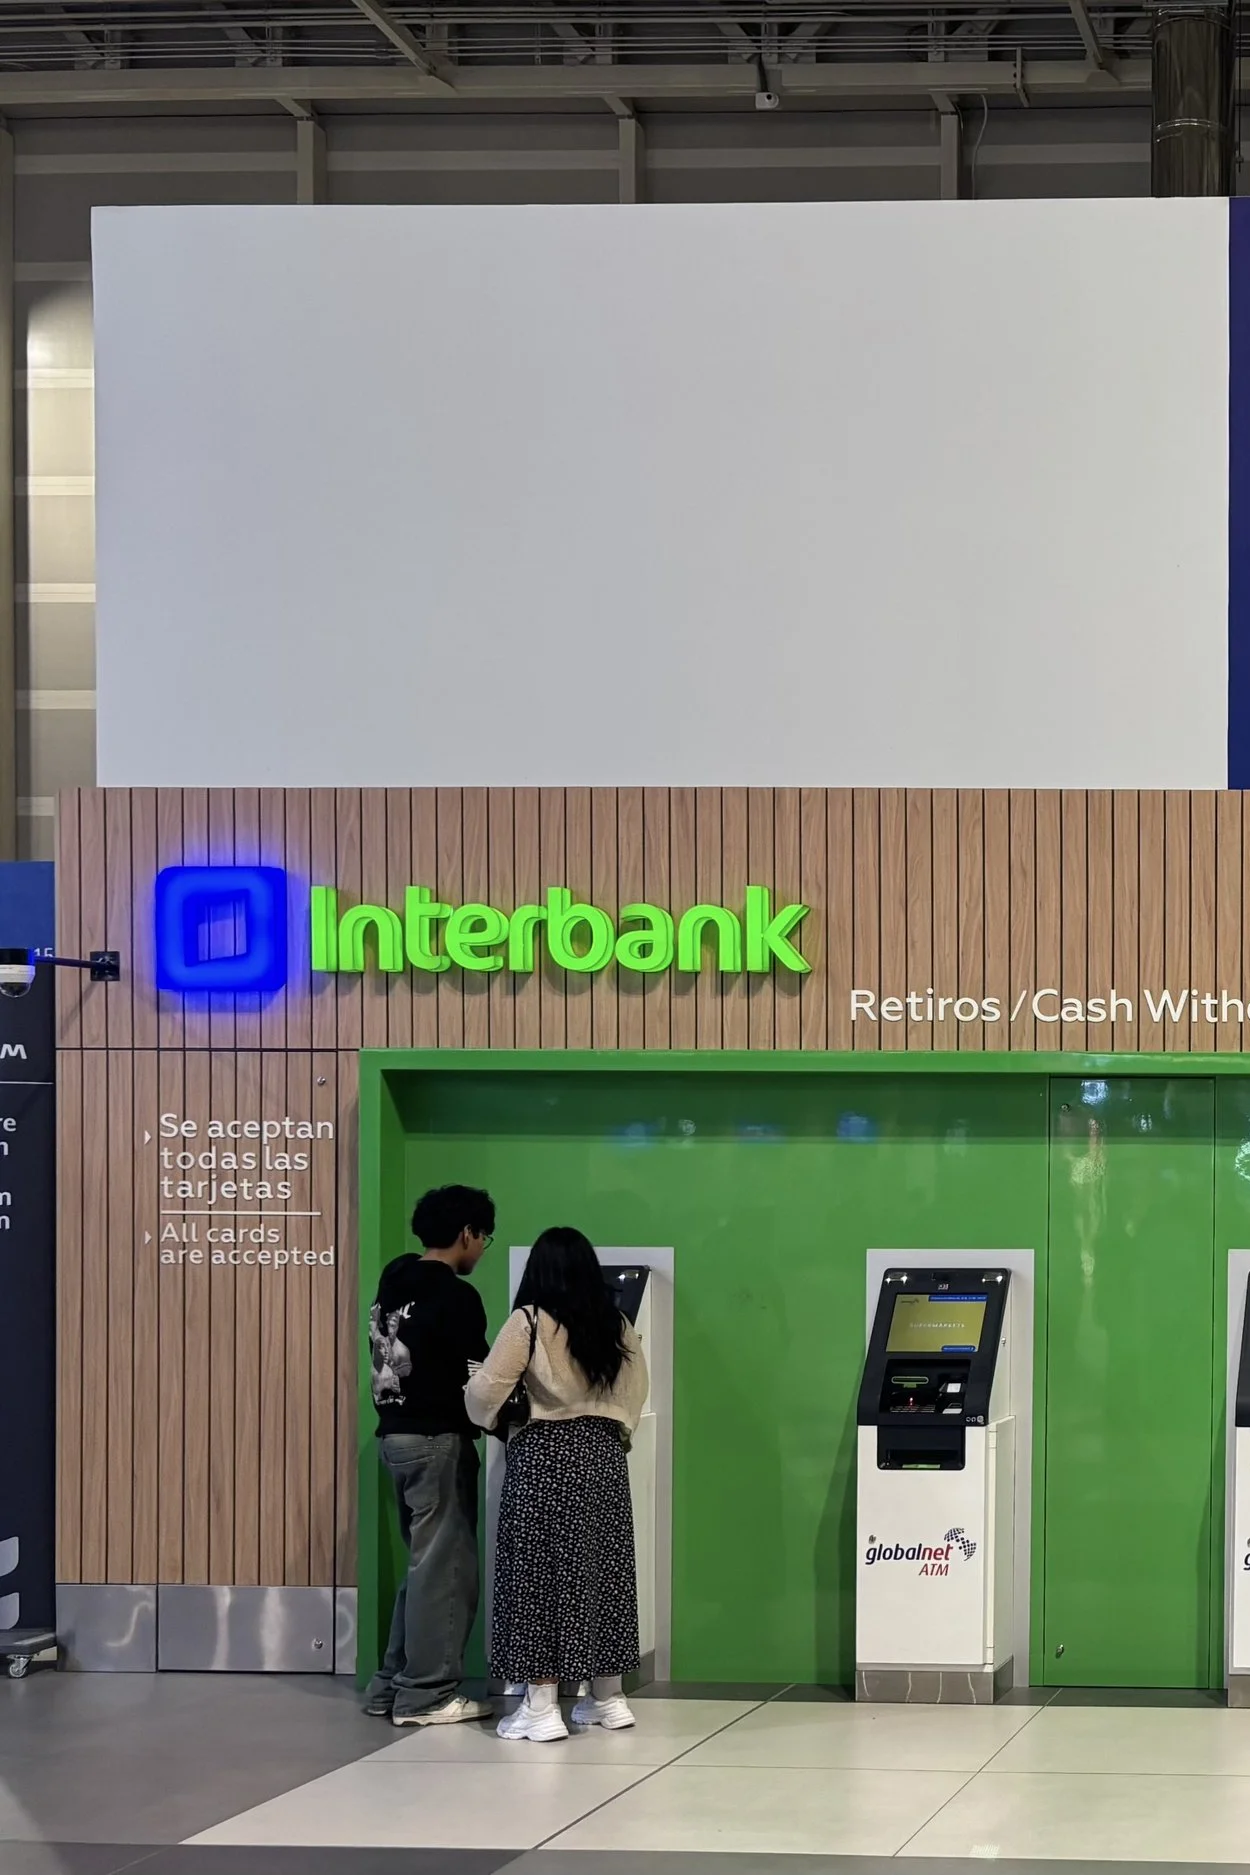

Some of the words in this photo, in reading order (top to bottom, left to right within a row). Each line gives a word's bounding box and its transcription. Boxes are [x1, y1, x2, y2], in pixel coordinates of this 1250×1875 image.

[310, 885, 812, 974] Interbank
[851, 988, 1000, 1021] Retiros
[160, 1113, 197, 1137] Se
[208, 1117, 333, 1144] aceptan
[160, 1146, 256, 1169] todas
[266, 1146, 307, 1169] las
[161, 1174, 291, 1204] tarjetas
[161, 1223, 198, 1242] All
[207, 1223, 279, 1242] cards
[161, 1250, 203, 1263] are
[212, 1246, 333, 1269] accepted
[865, 1543, 954, 1565] globalnet
[918, 1563, 950, 1576] ATM
